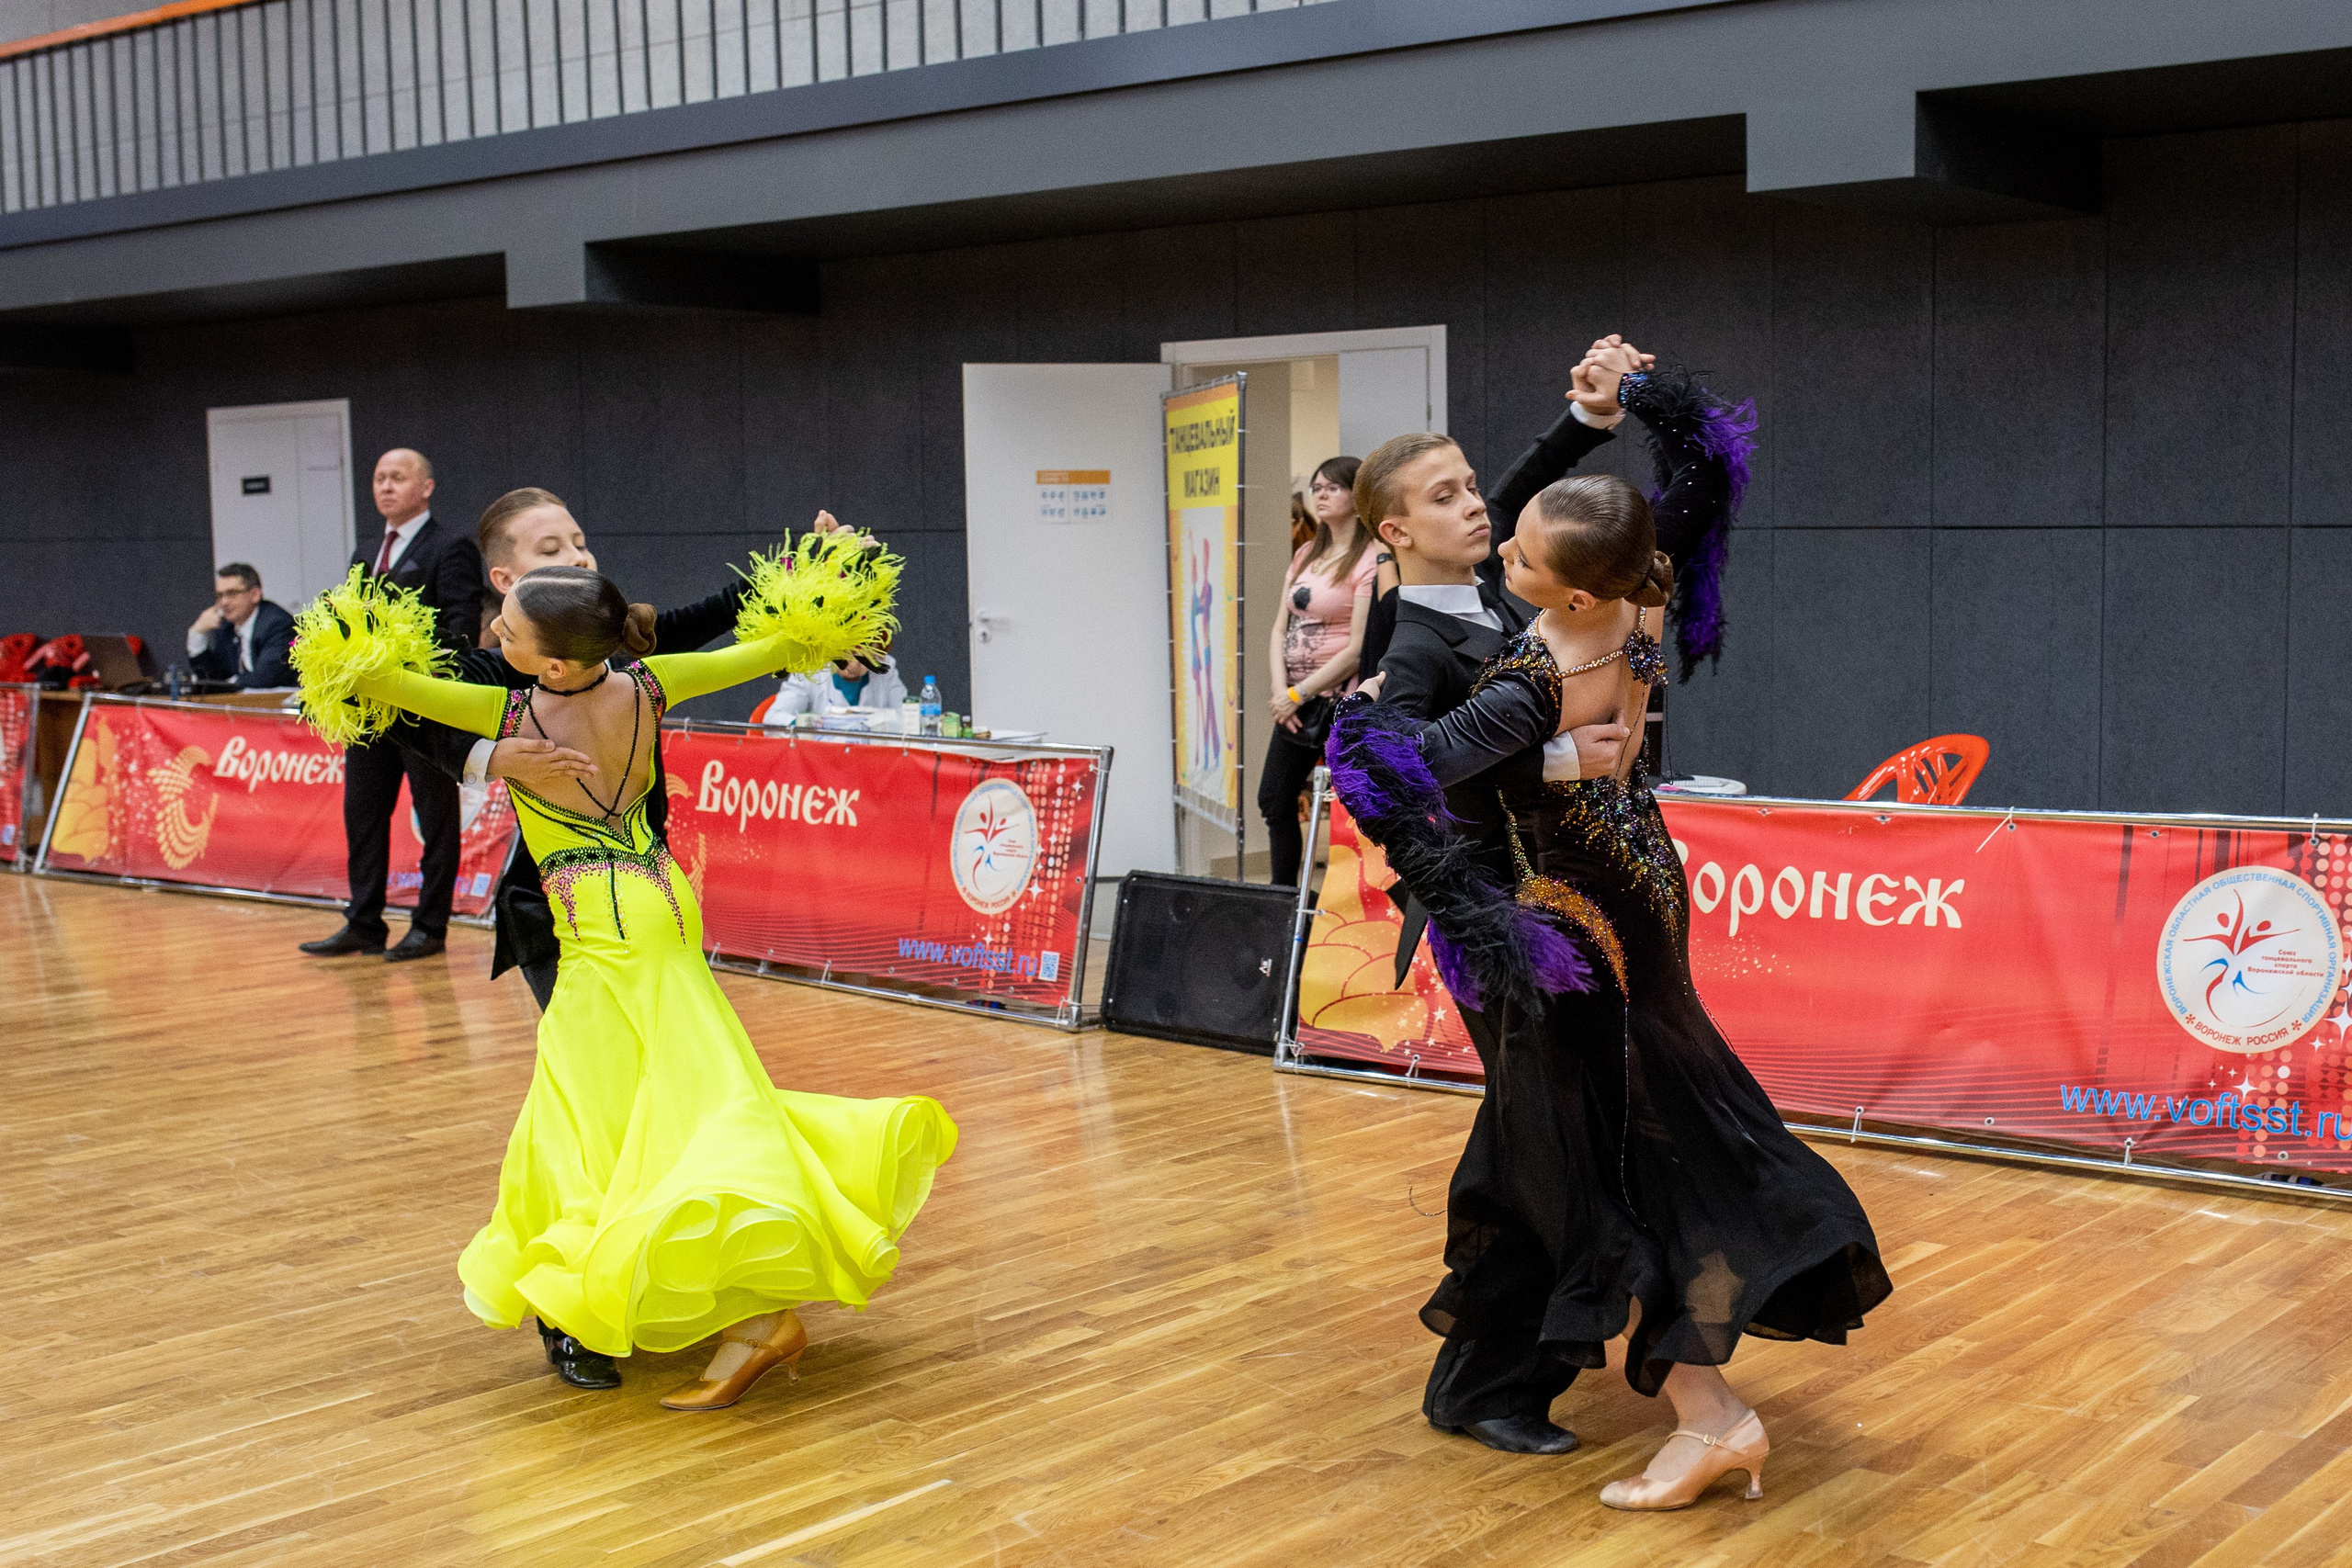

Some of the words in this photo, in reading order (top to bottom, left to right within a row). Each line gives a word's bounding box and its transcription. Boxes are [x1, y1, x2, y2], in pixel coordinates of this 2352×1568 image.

[1184, 467, 1220, 498] МАГАЗИН
[213, 736, 346, 793] Воронеж
[695, 760, 861, 833] Воронеж
[2212, 873, 2297, 890] ОБЩЕСТВЕННАЯ
[2168, 886, 2211, 937] ОБЛАСТНАЯ
[2296, 887, 2336, 949] СПОРТИВНАЯ
[899, 938, 1037, 976] www.voftsst.ru
[2164, 940, 2188, 1014] ВОРОНЕЖСКАЯ
[2301, 952, 2336, 1023] ОРГАНИЗАЦИЯ
[2194, 1021, 2242, 1045] ВОРОНЕЖ
[2246, 1027, 2290, 1045] РОССИЯ
[2061, 1084, 2352, 1141] www.voftsst.ru
